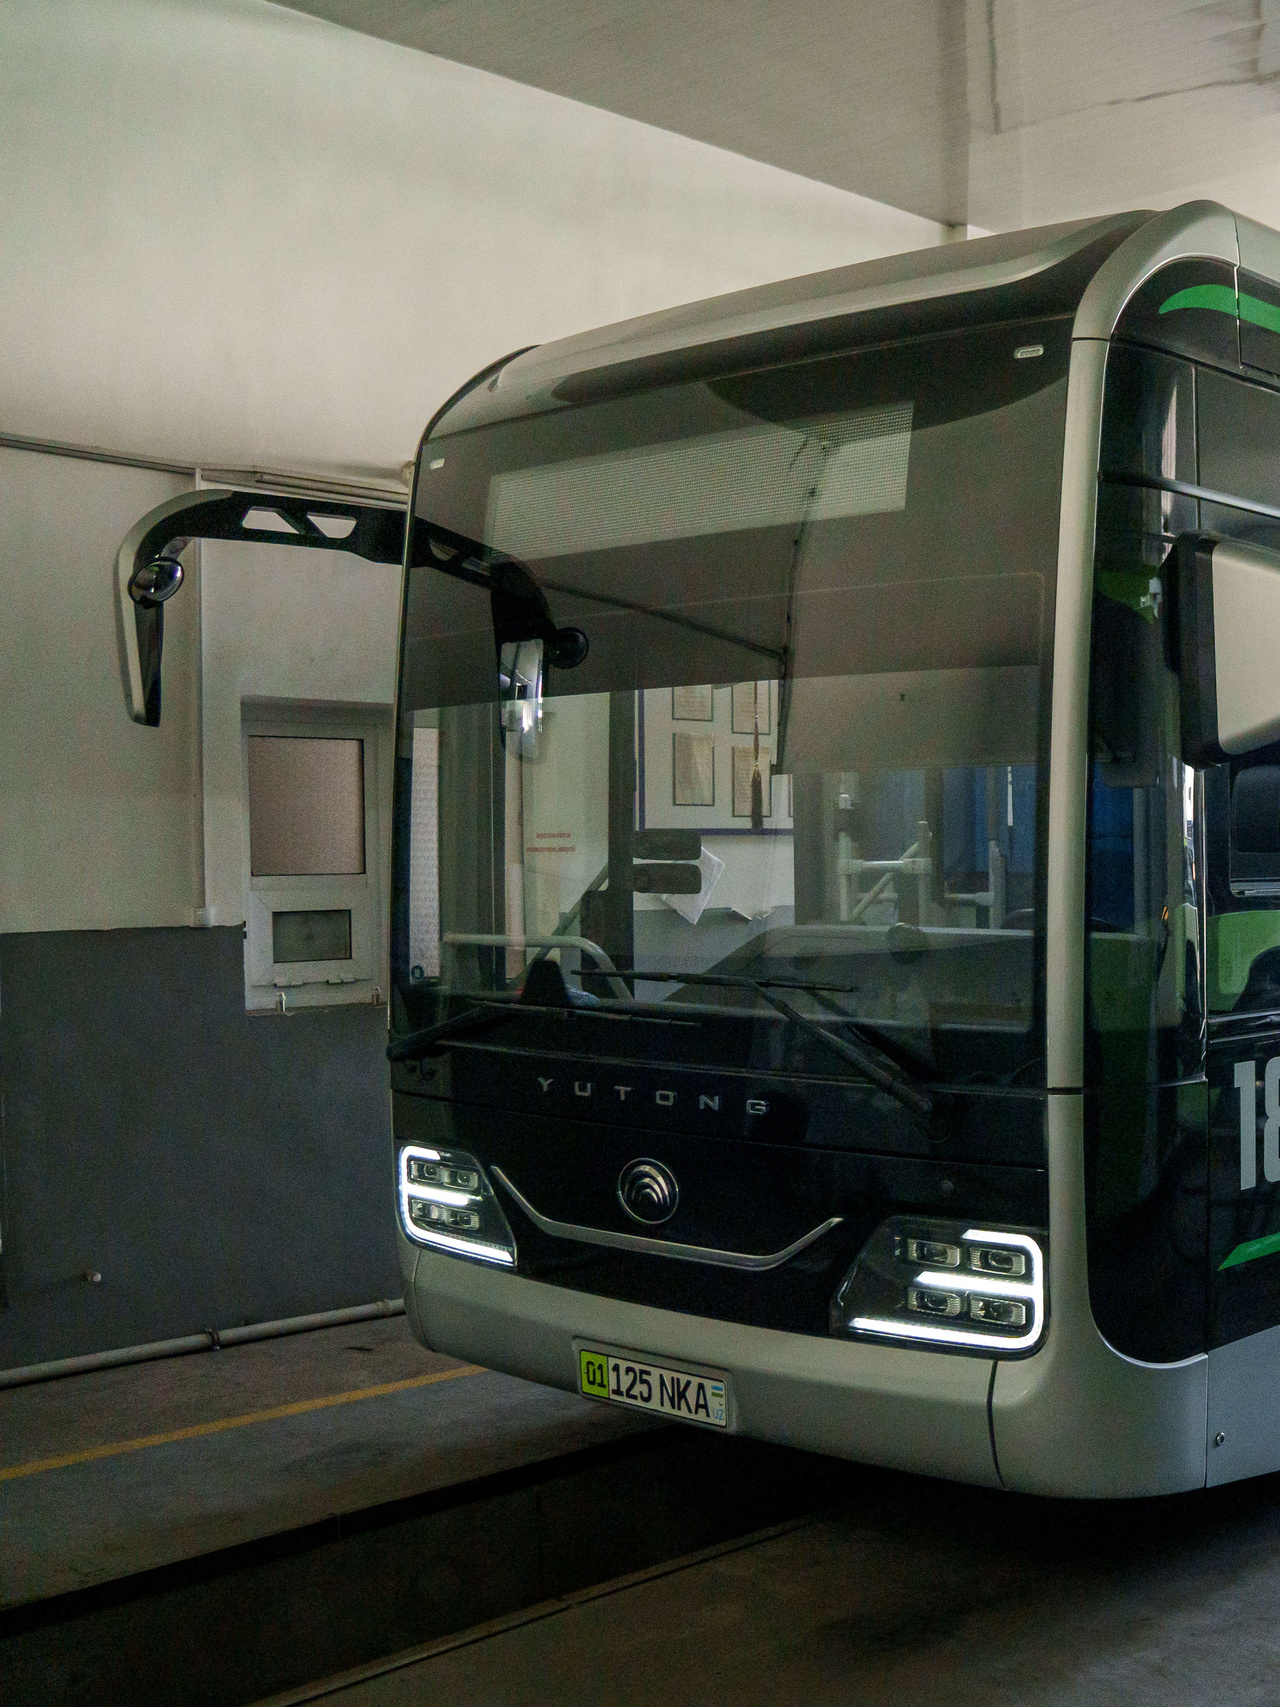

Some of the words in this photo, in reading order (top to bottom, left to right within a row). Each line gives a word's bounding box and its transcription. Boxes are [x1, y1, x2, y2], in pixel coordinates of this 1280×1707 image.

[537, 1076, 769, 1115] YUTONG
[586, 1360, 607, 1389] 01
[611, 1363, 653, 1403] 125
[659, 1373, 711, 1418] NKA
[712, 1407, 725, 1421] UZ
